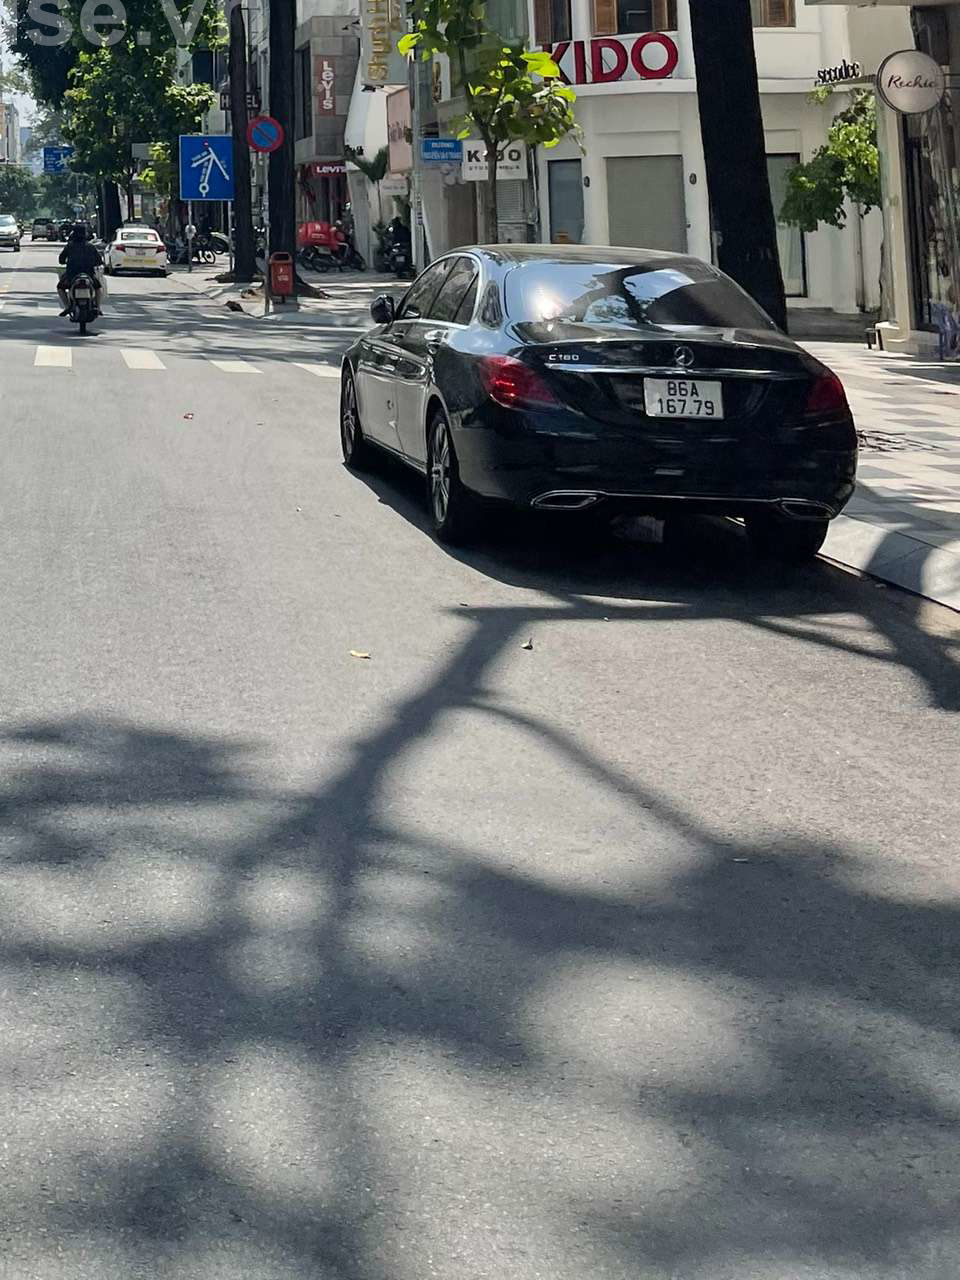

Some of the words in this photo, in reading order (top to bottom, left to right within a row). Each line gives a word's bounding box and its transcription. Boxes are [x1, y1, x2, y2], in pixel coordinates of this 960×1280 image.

[543, 31, 679, 87] KIDO
[221, 95, 258, 108] HEL
[667, 381, 699, 398] 86A
[658, 397, 715, 416] 167.79
